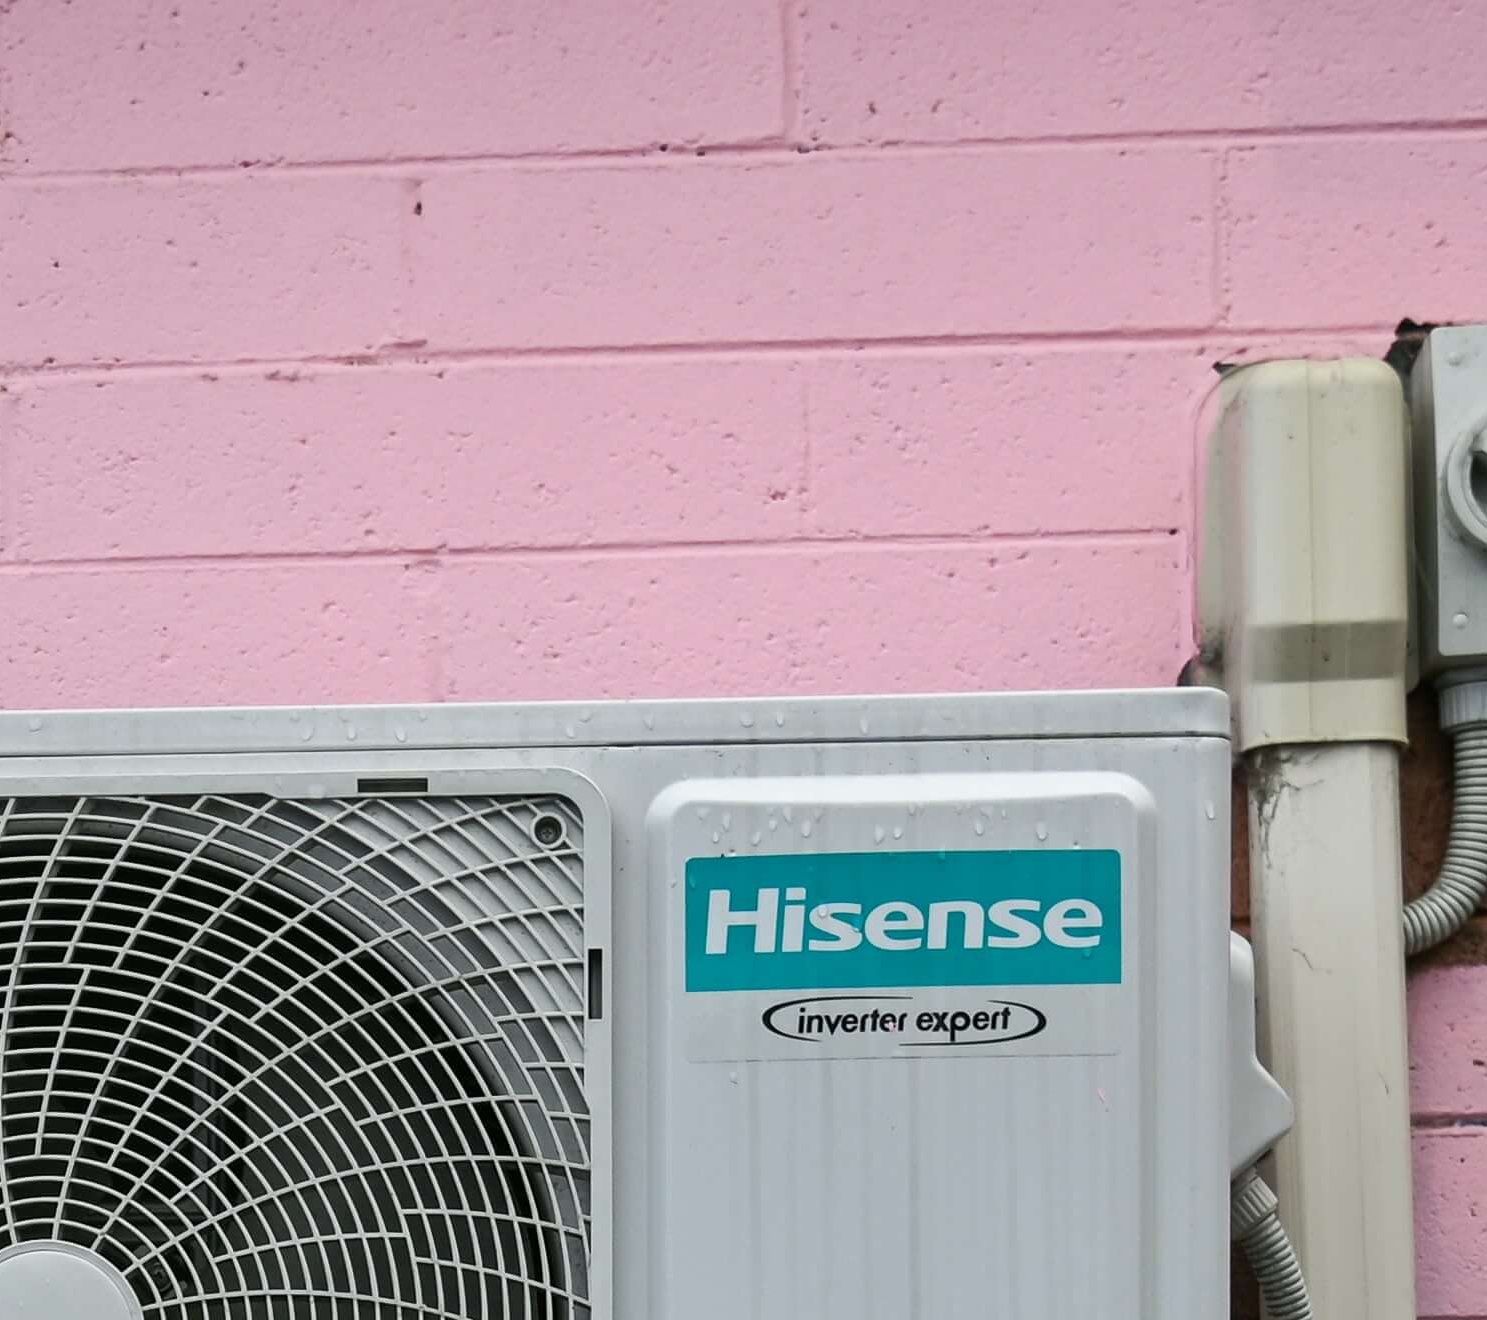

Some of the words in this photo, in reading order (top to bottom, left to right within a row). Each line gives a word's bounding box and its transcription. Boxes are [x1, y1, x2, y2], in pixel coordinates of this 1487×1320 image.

[705, 887, 1103, 955] Hisense
[797, 1007, 907, 1036] inverter
[915, 1006, 1012, 1042] expert
